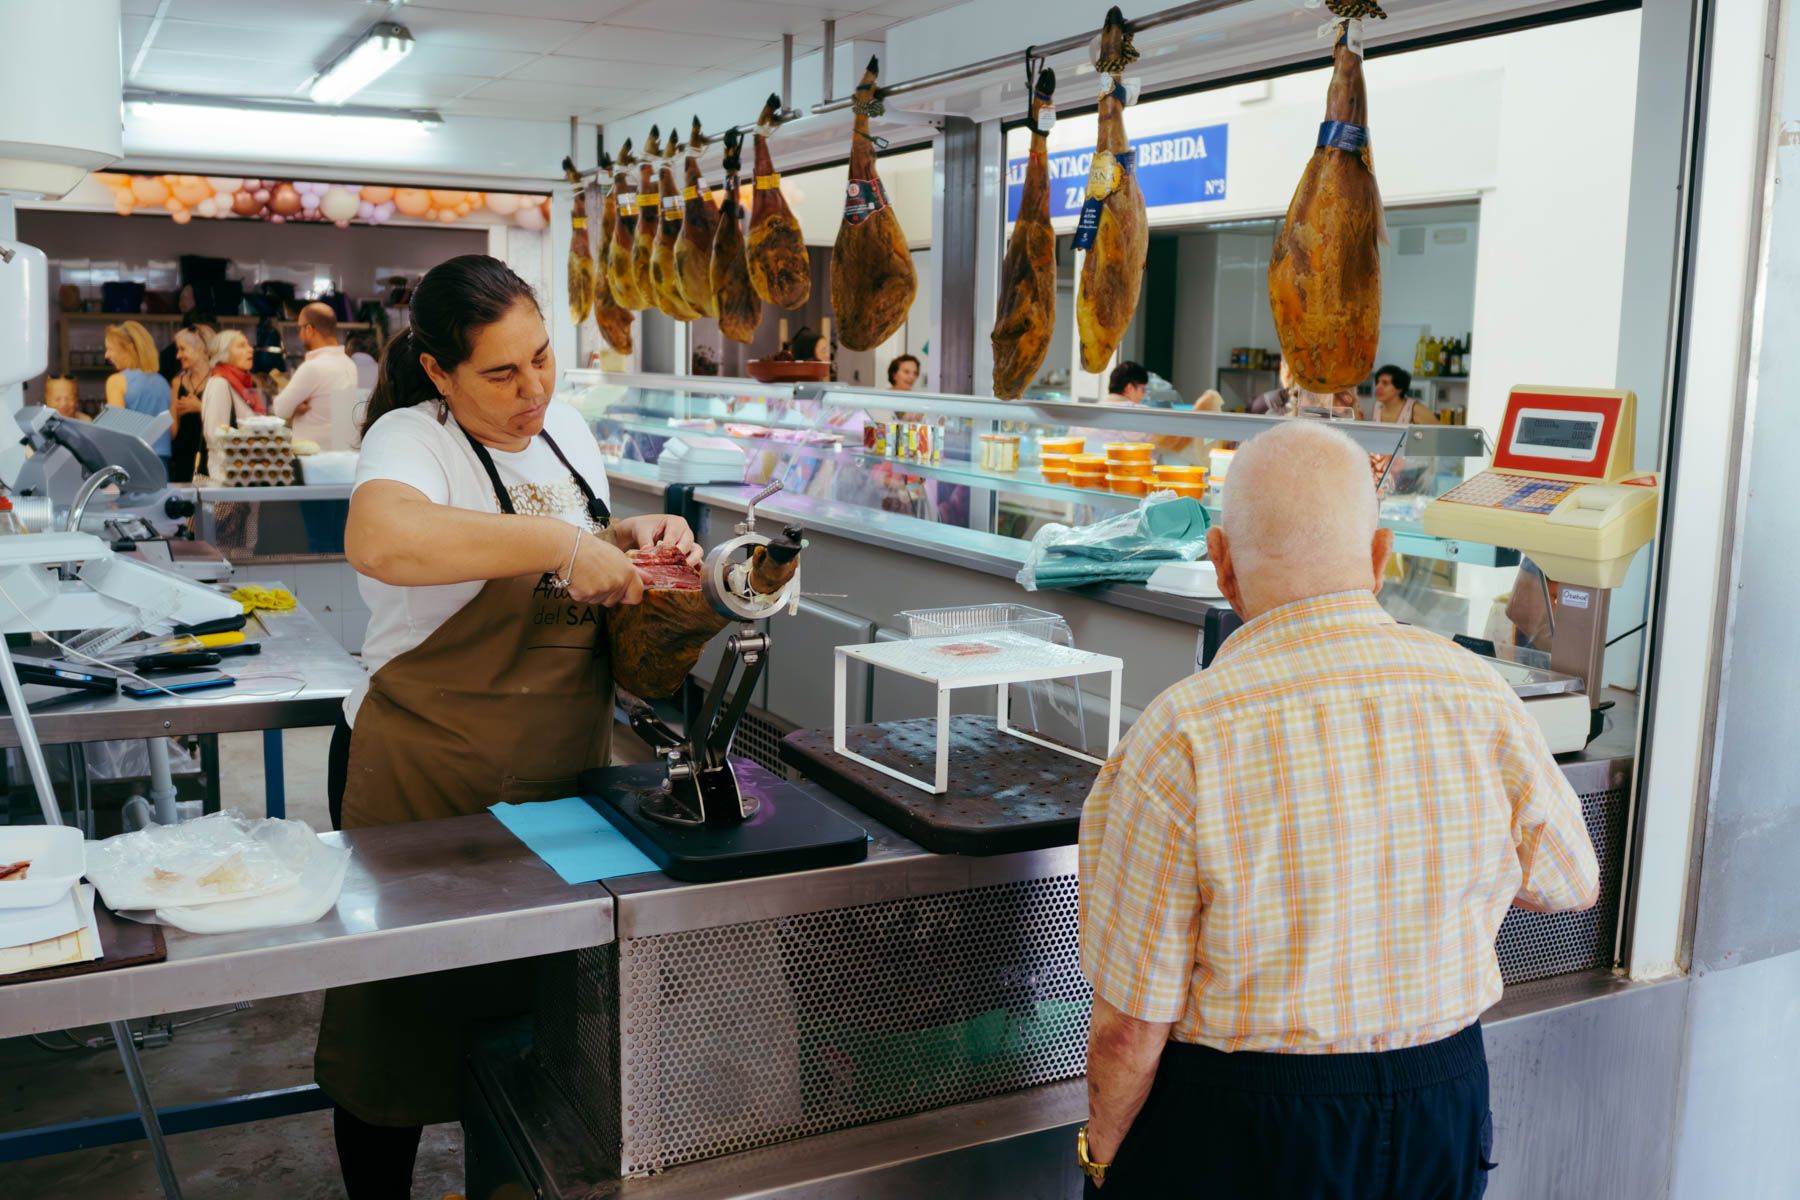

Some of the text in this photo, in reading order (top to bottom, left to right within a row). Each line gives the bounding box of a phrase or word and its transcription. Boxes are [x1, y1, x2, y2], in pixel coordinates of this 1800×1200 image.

[1138, 134, 1208, 167] BEBIDA
[1065, 185, 1087, 209] ZA
[534, 605, 597, 626] del SA
